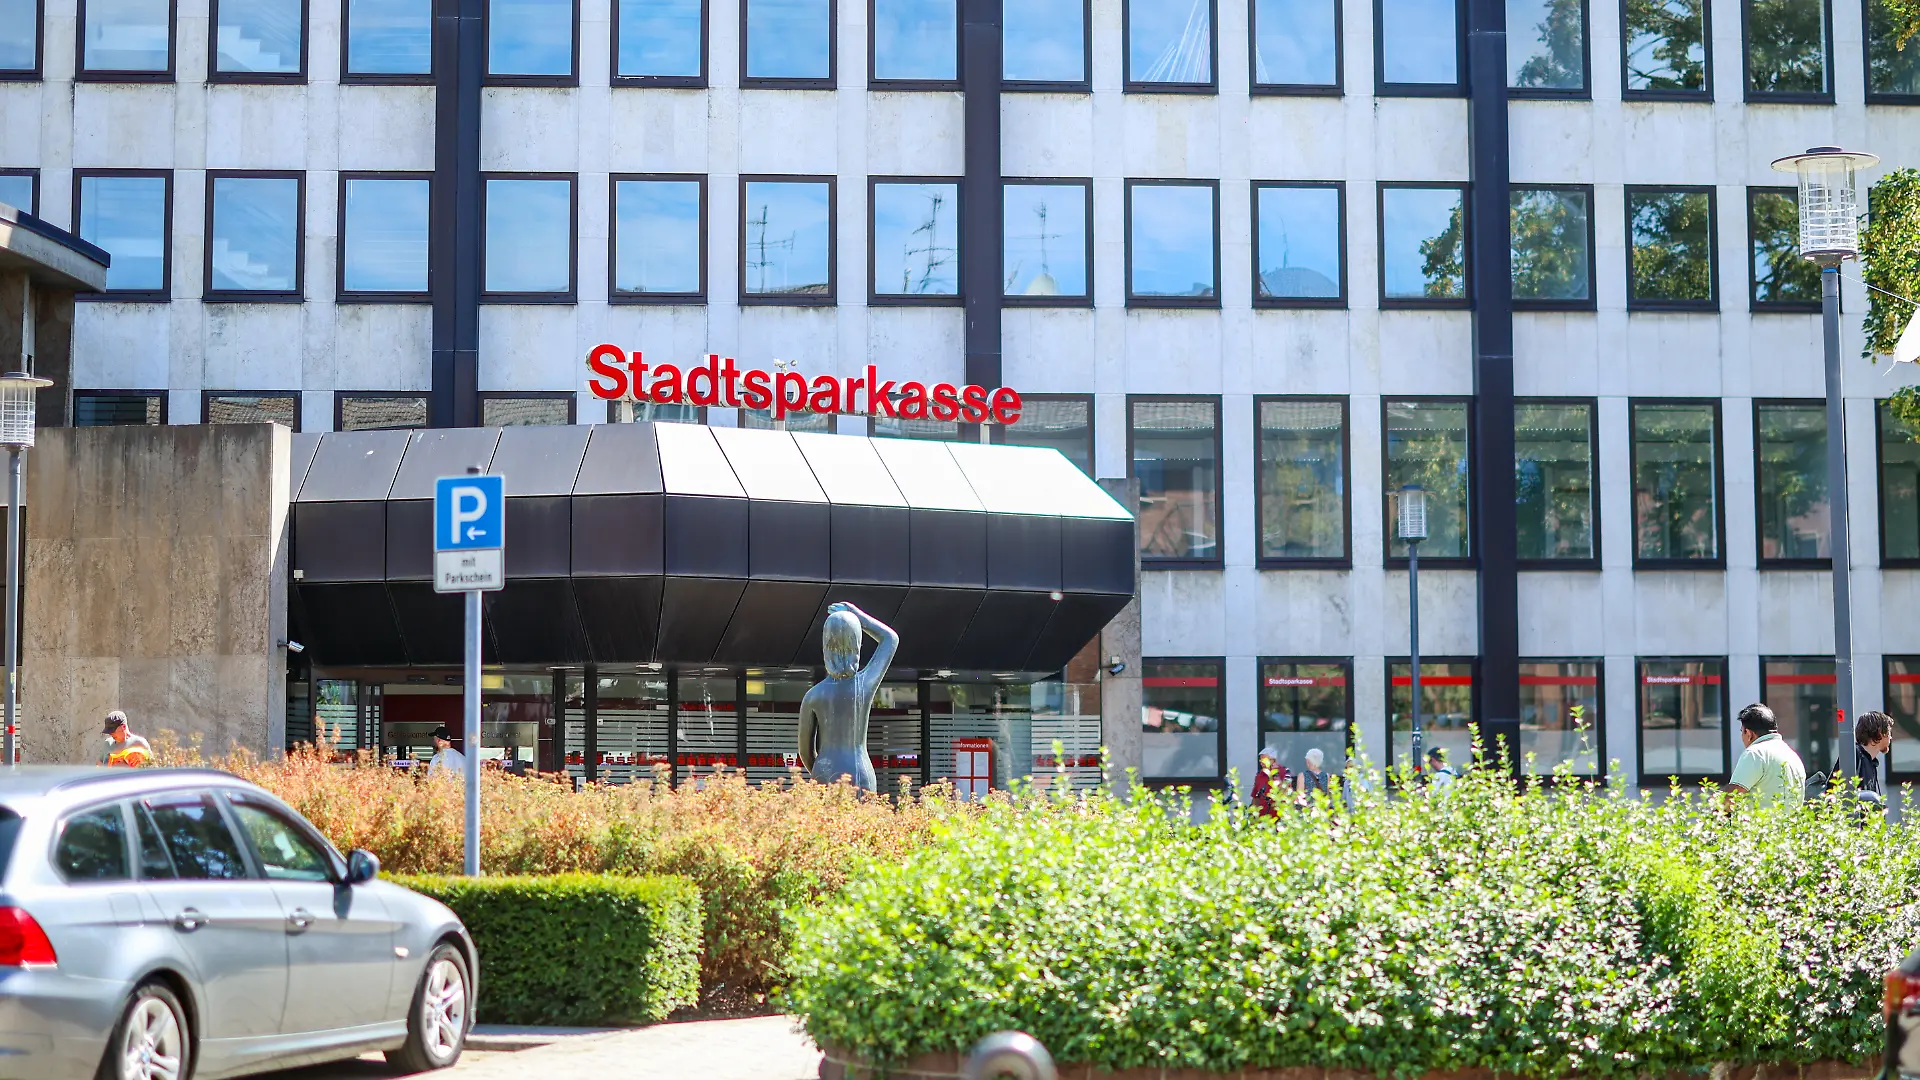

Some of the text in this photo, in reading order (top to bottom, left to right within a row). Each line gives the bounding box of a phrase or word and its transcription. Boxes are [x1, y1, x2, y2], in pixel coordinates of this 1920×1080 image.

[585, 343, 1022, 425] Stadtsparkasse
[451, 486, 487, 544] P
[445, 572, 493, 584] Parkschein
[461, 557, 477, 567] mit
